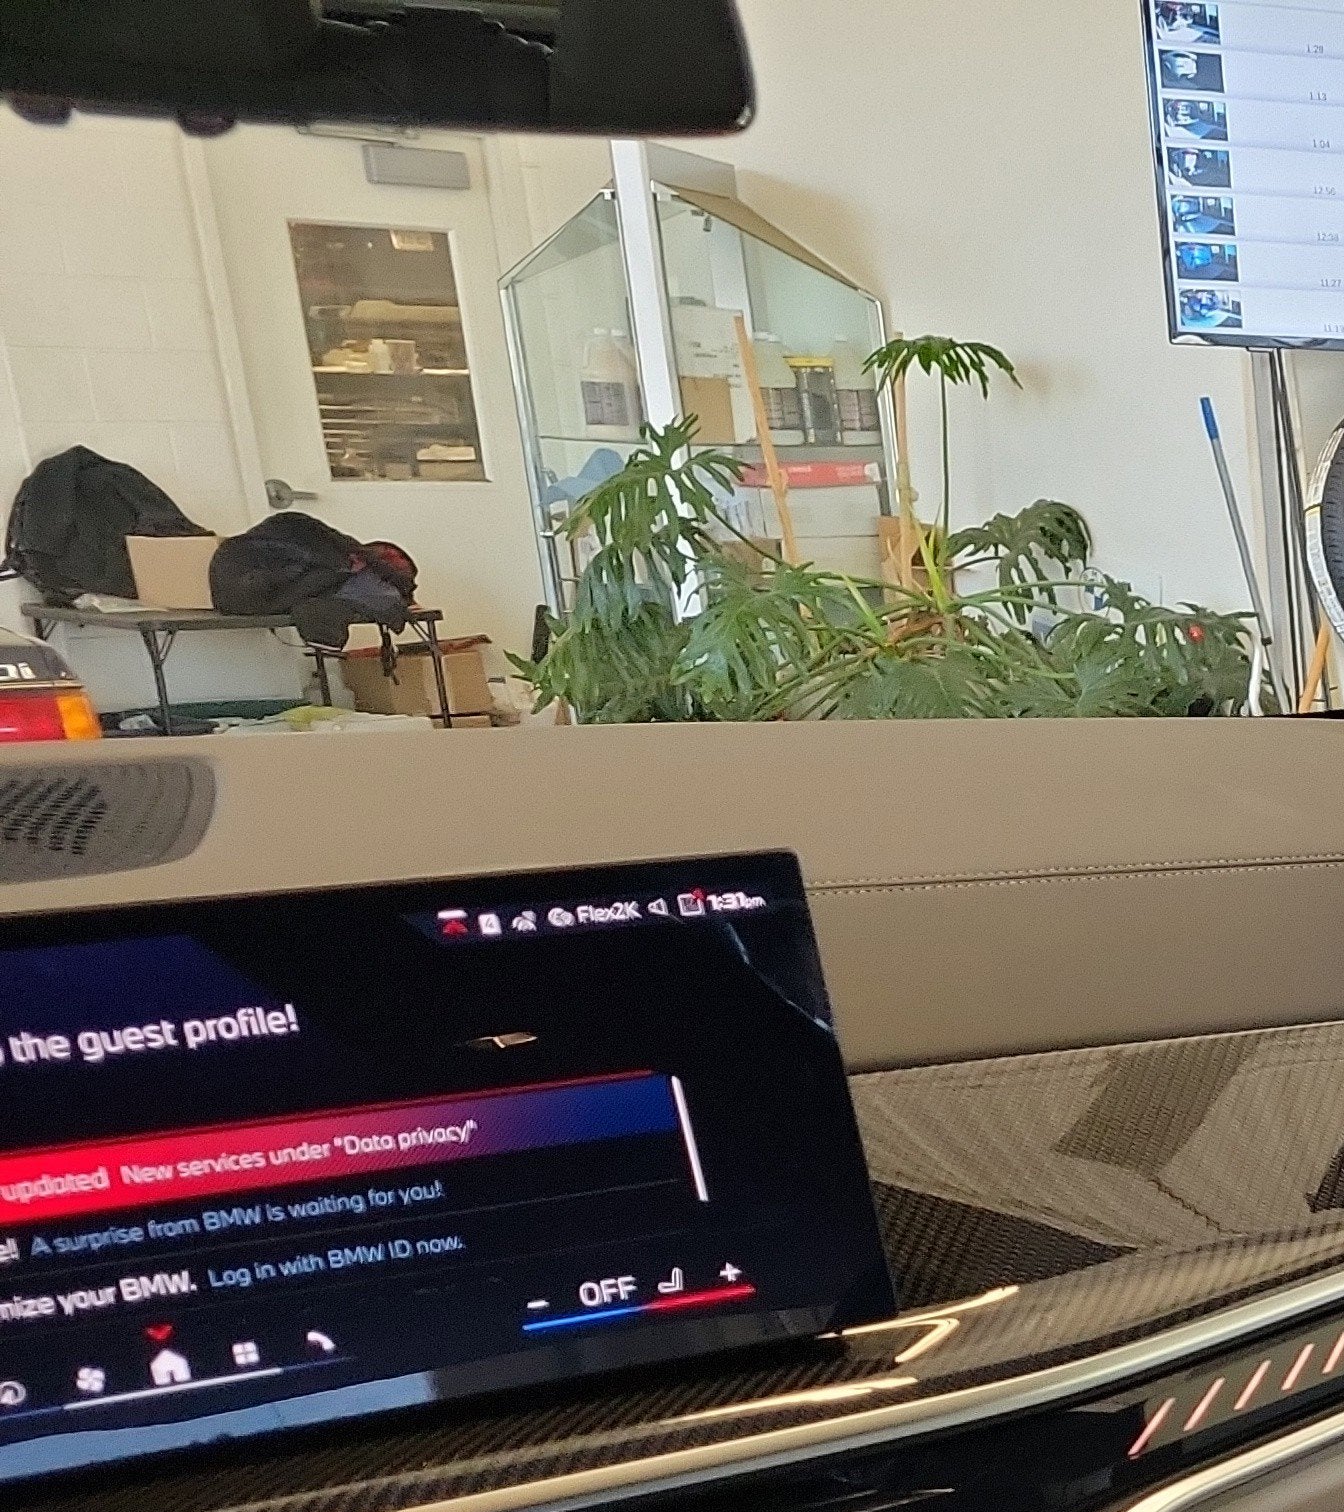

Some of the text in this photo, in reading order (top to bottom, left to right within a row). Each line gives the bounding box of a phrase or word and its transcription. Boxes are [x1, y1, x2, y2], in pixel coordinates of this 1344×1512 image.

[576, 901, 643, 925] Flex2K
[9, 1003, 300, 1064] the guest profile!
[0, 1166, 110, 1205] updated
[120, 1162, 174, 1186] New
[176, 1151, 267, 1179] services
[268, 1141, 332, 1167] under
[30, 1235, 53, 1257] A
[53, 1225, 146, 1254] surprise
[148, 1216, 200, 1240] from
[201, 1204, 262, 1233] BMW
[267, 1201, 283, 1222] is
[287, 1190, 365, 1219] waiting
[367, 1186, 396, 1206] for
[398, 1179, 445, 1205] you!
[57, 1286, 118, 1319] your
[118, 1270, 197, 1303] BMW.
[207, 1264, 251, 1290] Log
[255, 1260, 277, 1281] in
[280, 1251, 325, 1278] with
[327, 1243, 387, 1271] BMW
[389, 1238, 413, 1260] ID
[416, 1232, 466, 1256] now.
[578, 1274, 639, 1307] OFF
